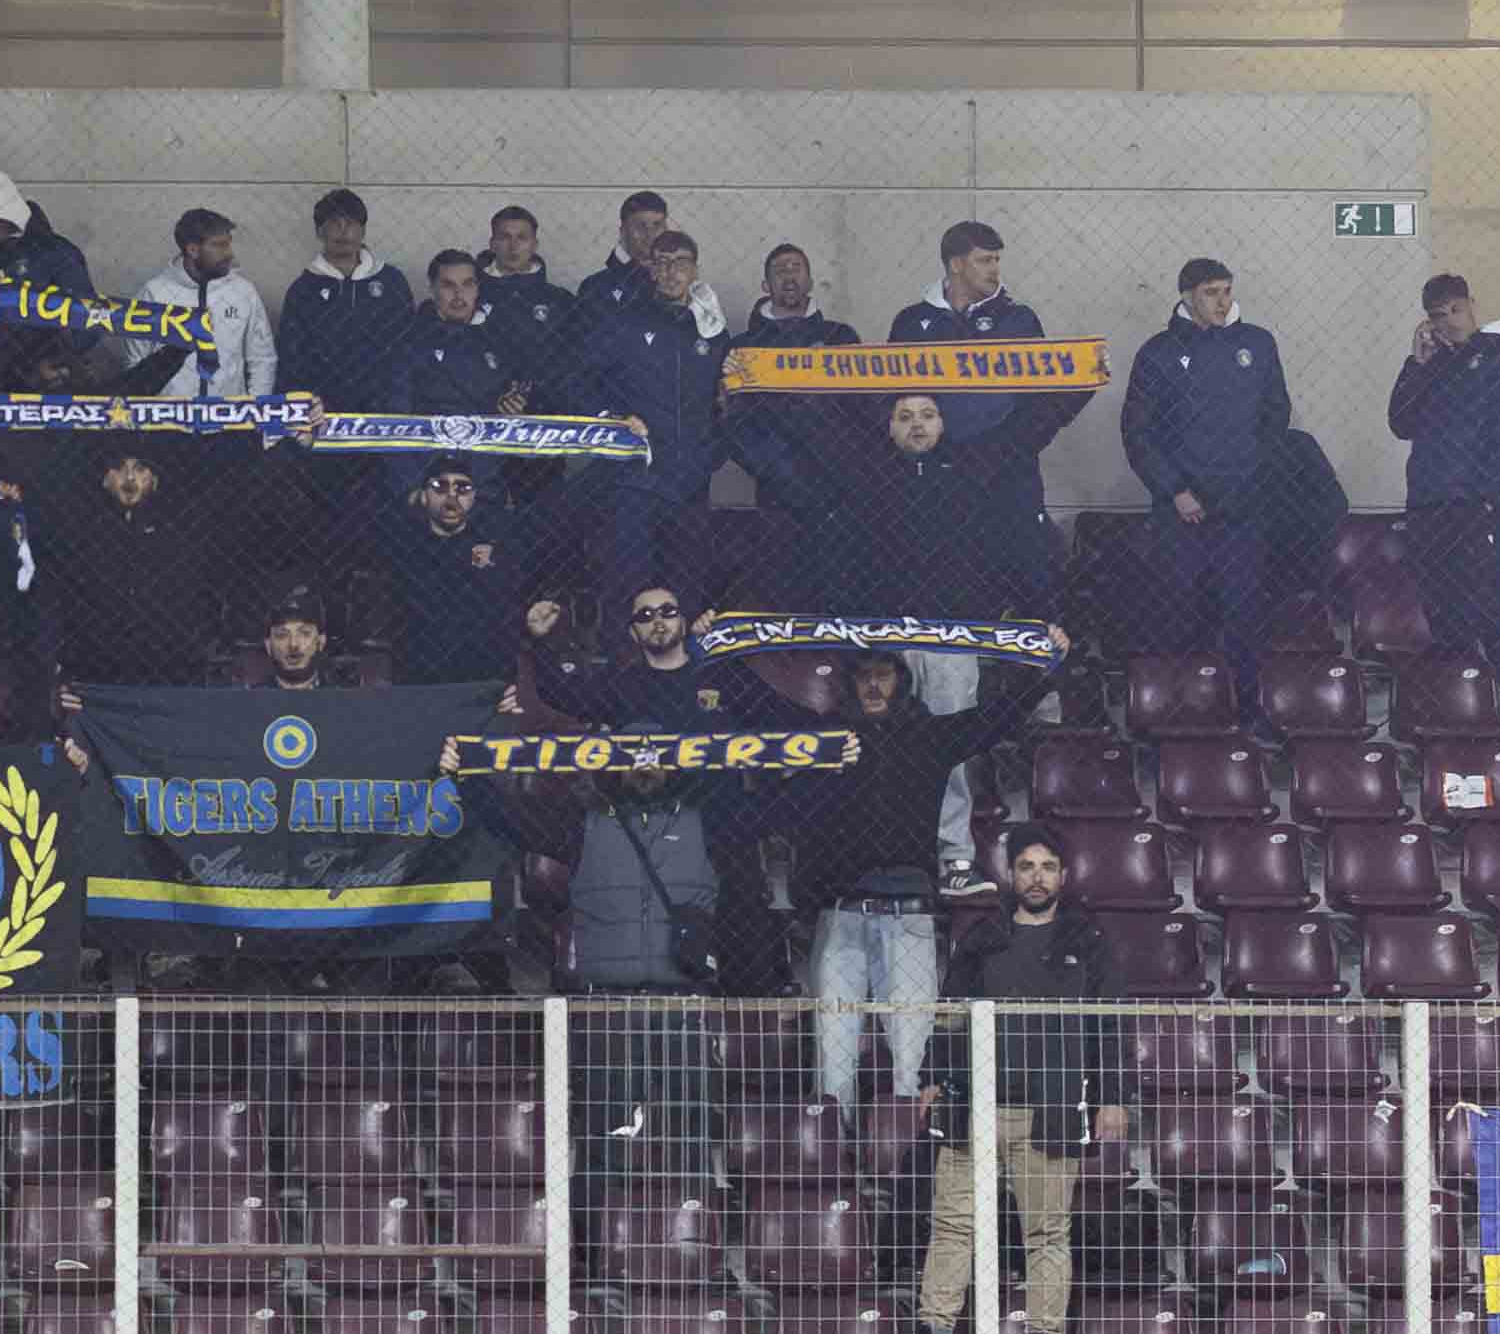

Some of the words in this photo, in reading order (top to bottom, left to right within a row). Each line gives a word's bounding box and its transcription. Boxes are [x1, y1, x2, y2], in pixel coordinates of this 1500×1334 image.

[128, 401, 312, 423] ΤΡΙΠΟΛΗΣ
[111, 774, 279, 837] TIGERS
[288, 776, 465, 839] ATHENS
